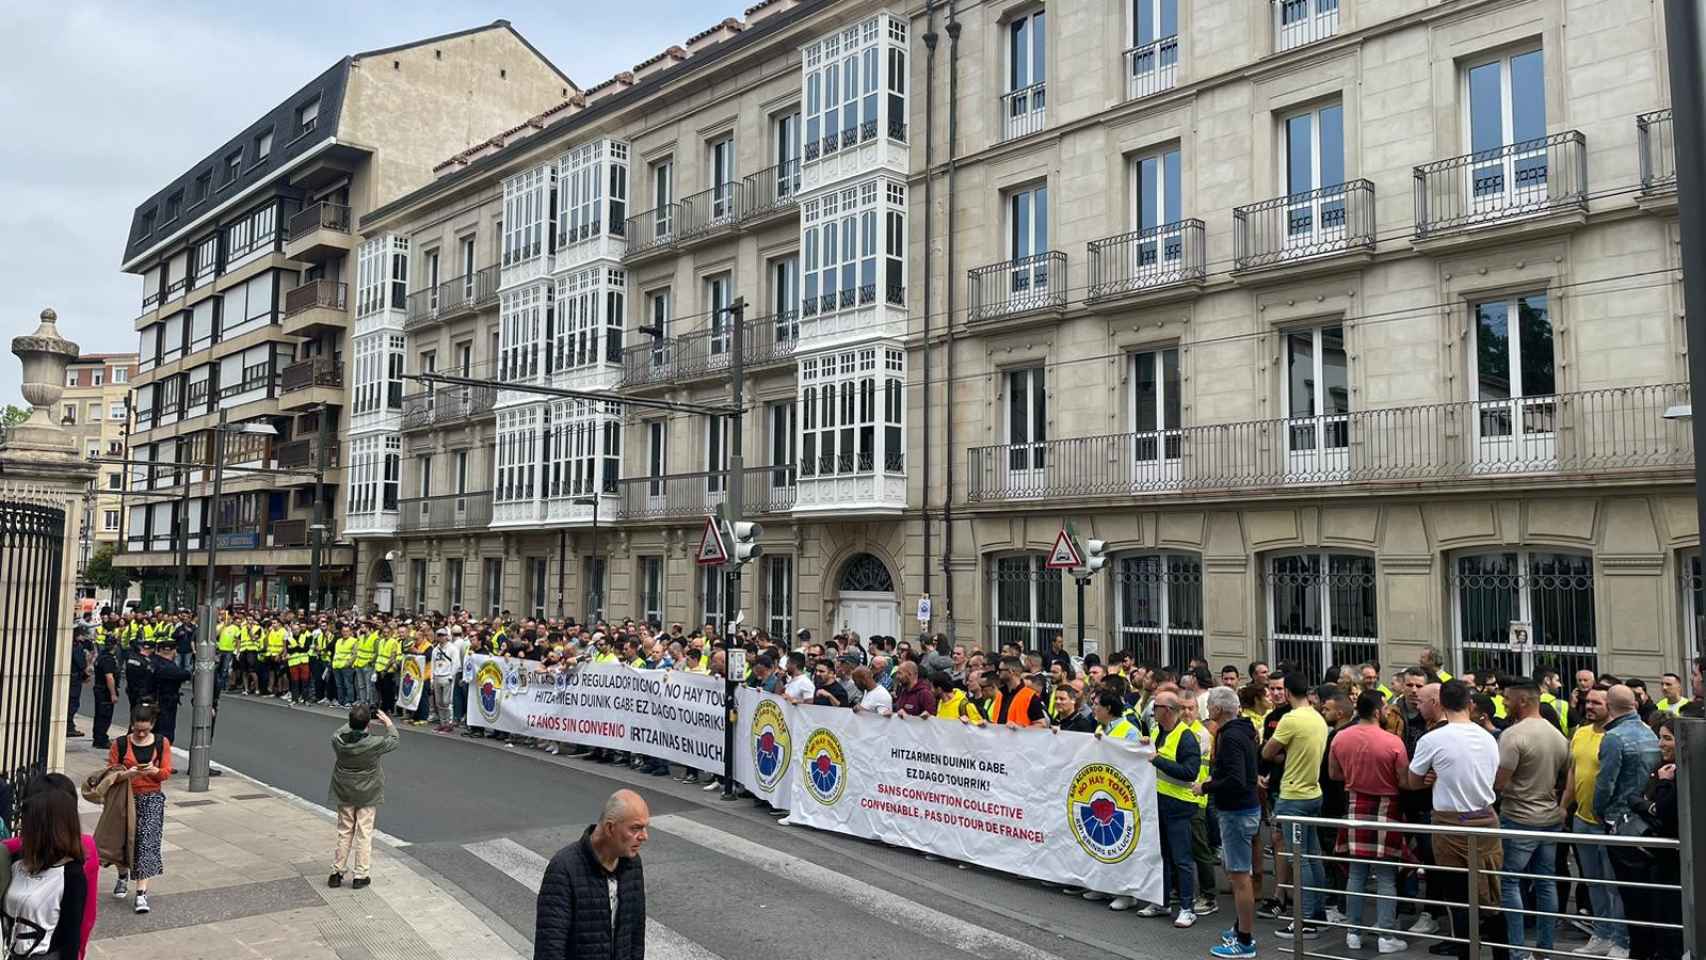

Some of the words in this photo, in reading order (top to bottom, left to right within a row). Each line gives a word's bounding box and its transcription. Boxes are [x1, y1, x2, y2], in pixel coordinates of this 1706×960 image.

[582, 673, 630, 689] REGULADOR
[664, 684, 681, 699] NO
[683, 686, 703, 703] HAY
[705, 689, 726, 707] TOU
[580, 694, 611, 709] DUINIK
[636, 699, 648, 714] EZ
[651, 702, 676, 720] DAGO
[678, 708, 724, 731] TOURRIK!
[527, 714, 536, 729] 12
[562, 718, 577, 732] SIN
[579, 719, 625, 738] CONVENIO
[681, 737, 694, 754] EN
[696, 742, 725, 763] LUCH
[891, 748, 941, 764] HITZARMEN
[943, 755, 976, 770] DUINIK
[978, 761, 1008, 776] GABE,
[1076, 765, 1104, 783] ACUERDO
[906, 767, 918, 779] EZ
[919, 769, 944, 783] DAGO
[945, 774, 990, 791] TOURRIK!
[1078, 782, 1088, 796] NO
[1088, 775, 1105, 785] HAY
[1108, 779, 1130, 803] TOUR
[878, 783, 901, 796] SANS
[902, 788, 961, 808] CONVENTION
[963, 799, 1023, 819] COLLECTIVE
[924, 810, 943, 822] PAS
[944, 814, 957, 825] DU
[958, 816, 984, 832] TOUR
[985, 822, 999, 834] DE
[1000, 824, 1045, 843] FRANCE!
[1107, 848, 1117, 856] EN
